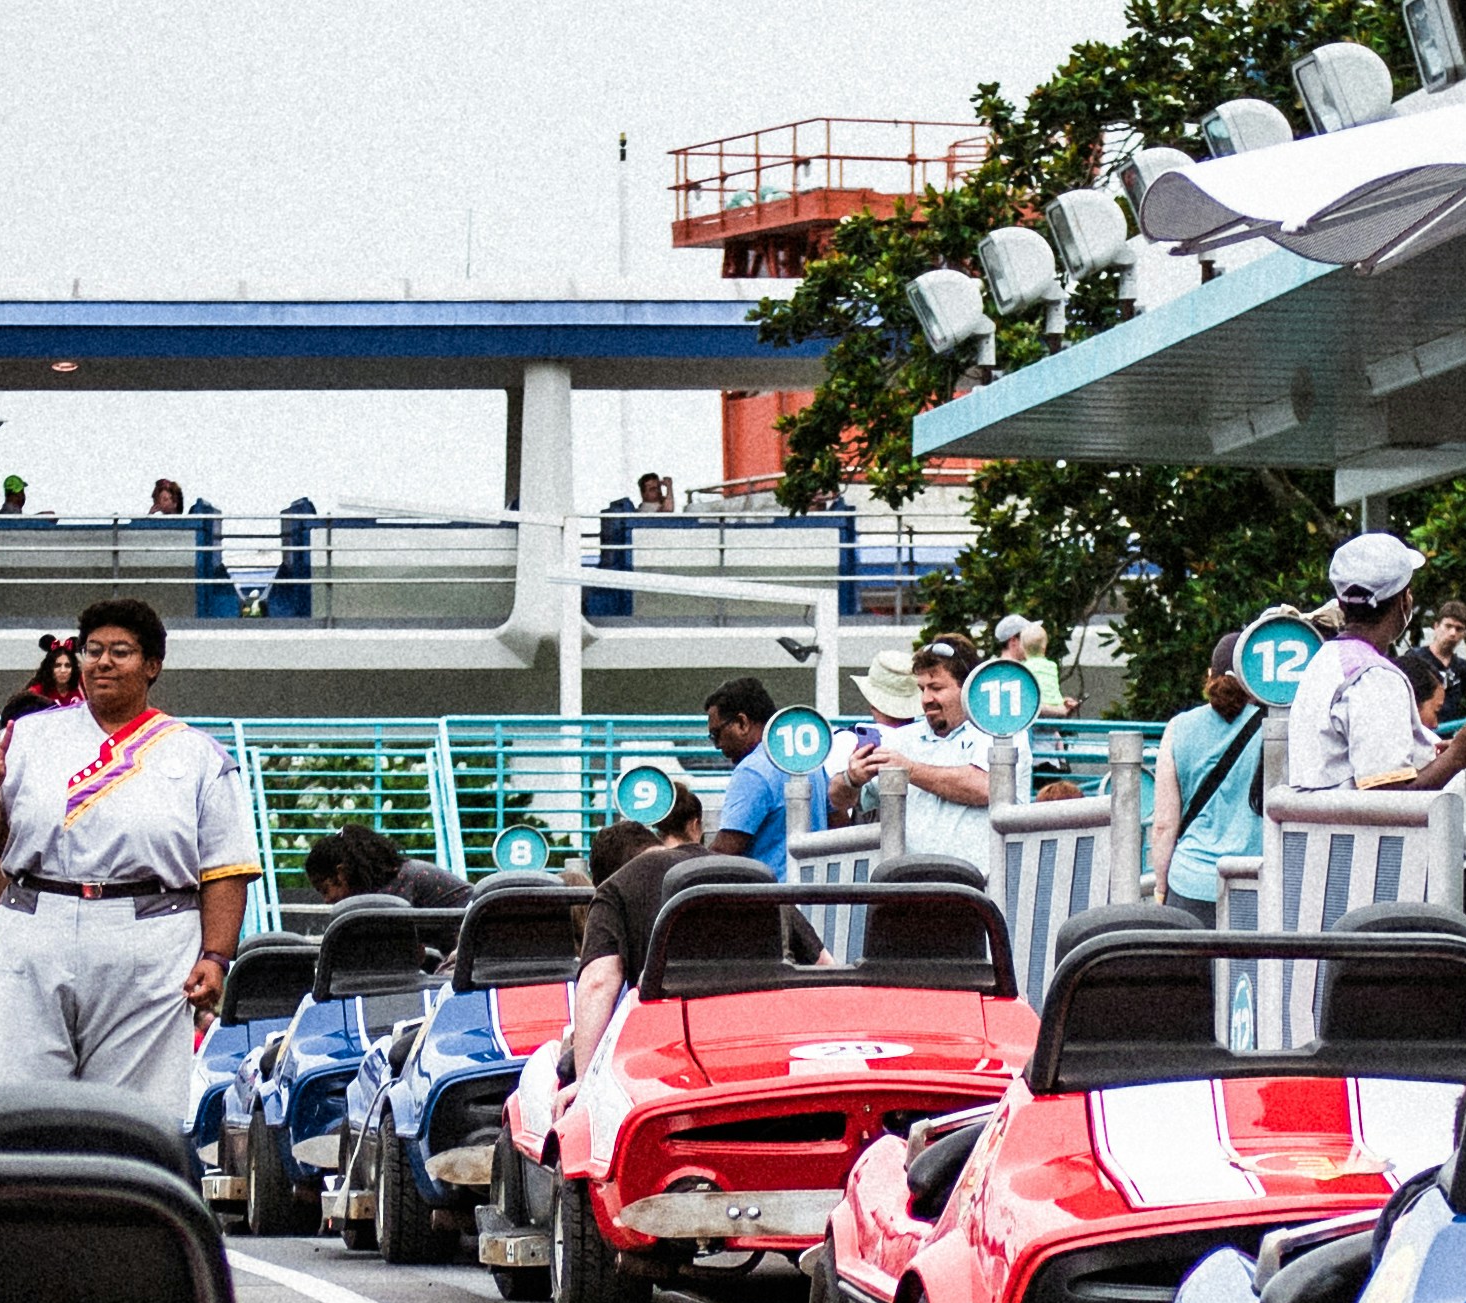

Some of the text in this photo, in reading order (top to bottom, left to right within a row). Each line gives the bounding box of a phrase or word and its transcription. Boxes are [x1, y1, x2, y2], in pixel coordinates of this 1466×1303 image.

[1251, 639, 1310, 683] 12
[980, 679, 1022, 717] 11
[775, 723, 821, 758] 10
[633, 780, 658, 810] 9
[509, 839, 532, 866] 8
